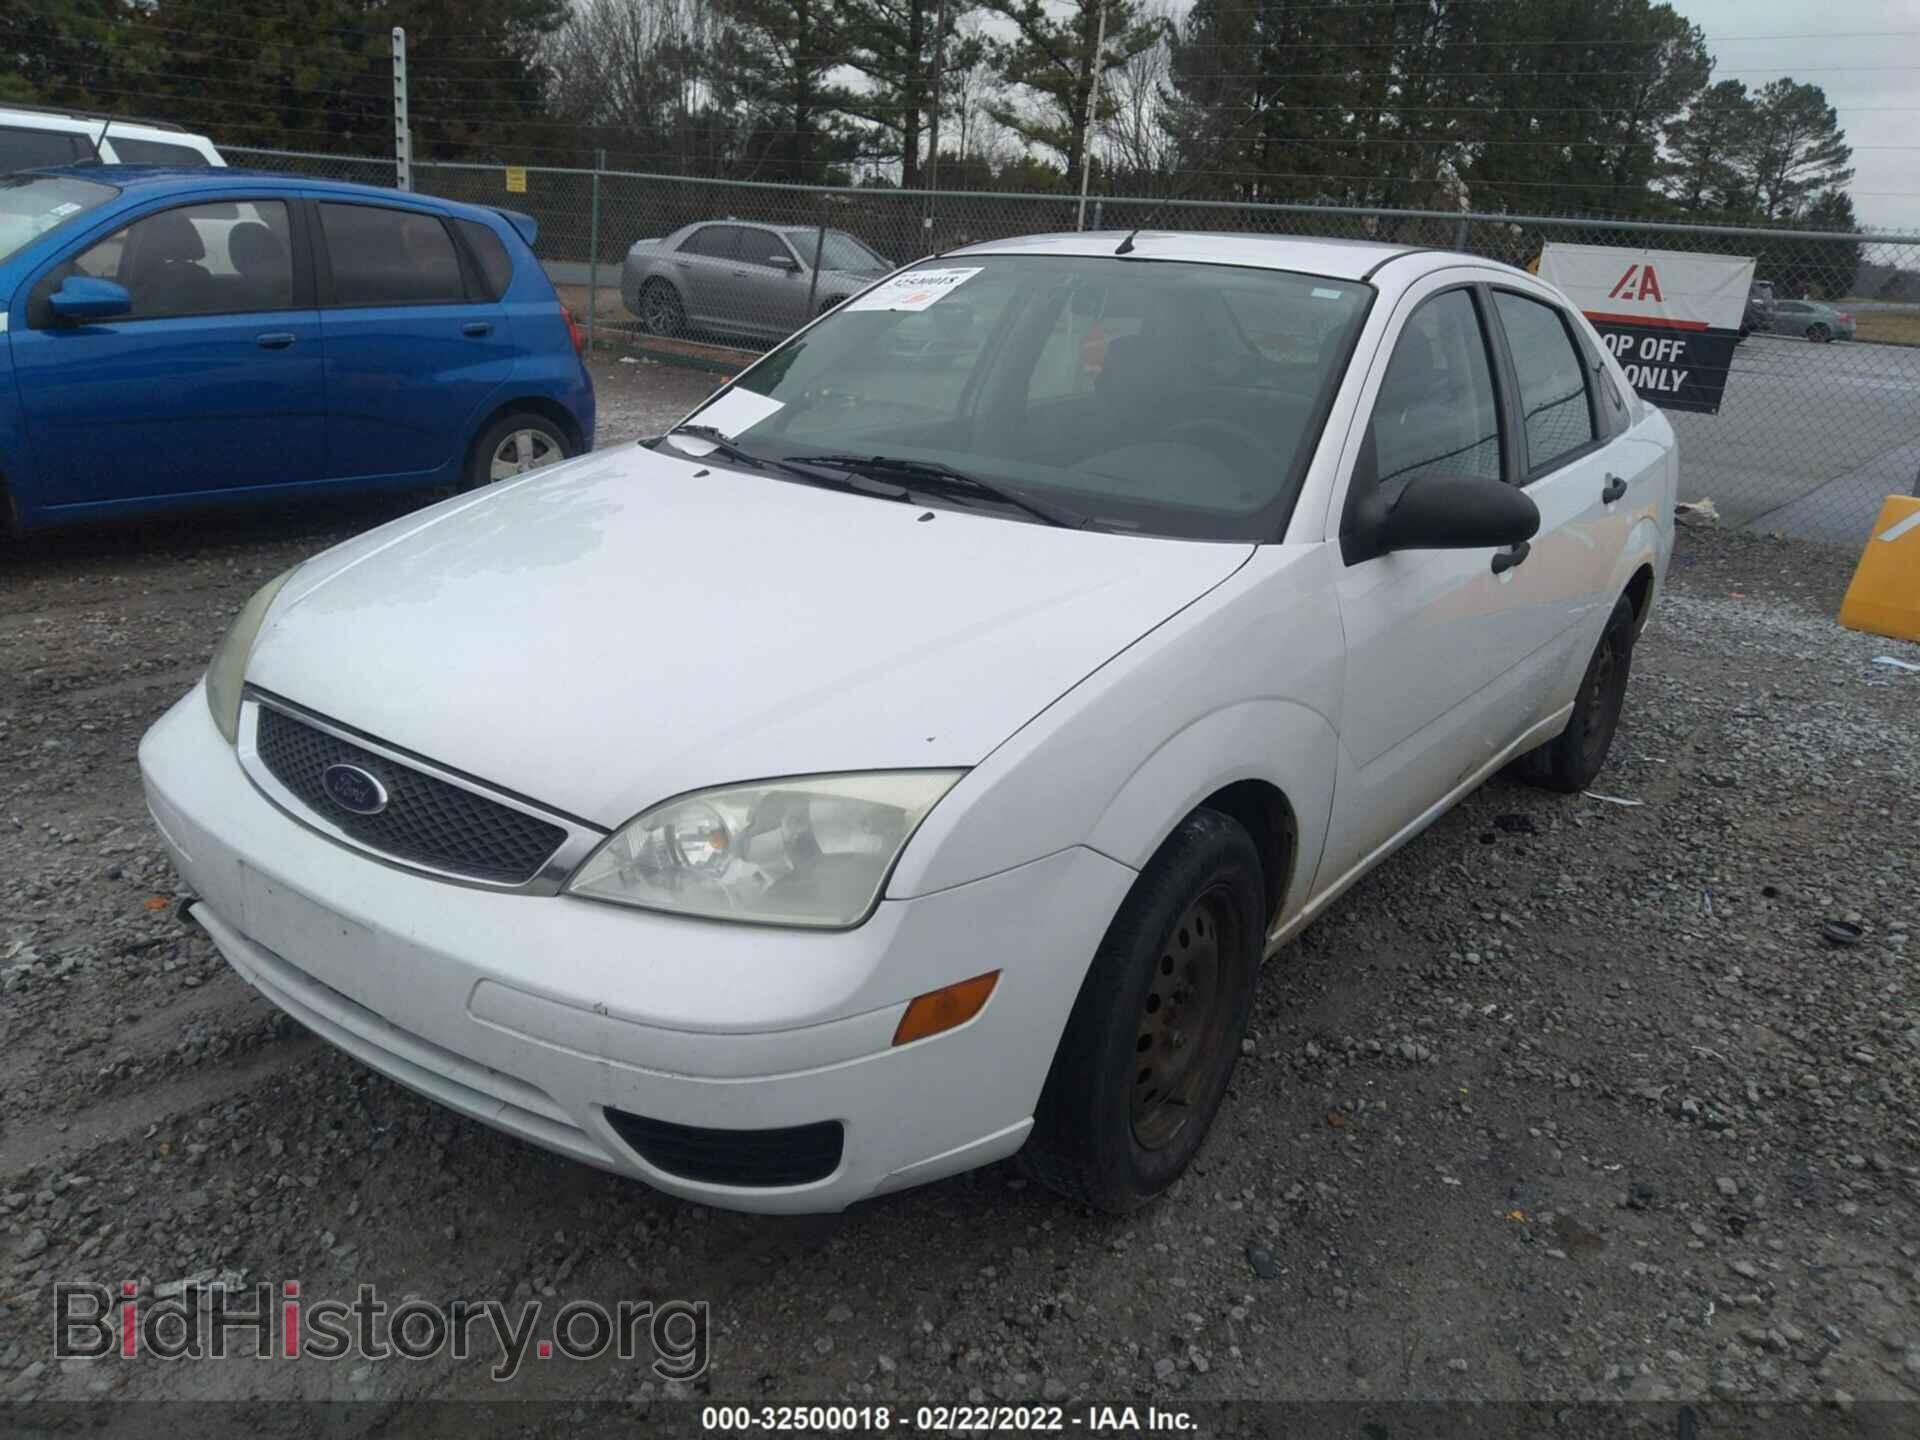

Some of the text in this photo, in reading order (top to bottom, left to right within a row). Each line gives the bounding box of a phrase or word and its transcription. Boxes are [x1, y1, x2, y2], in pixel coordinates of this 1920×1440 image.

[1602, 333, 1686, 362] OP OFF
[1624, 364, 1688, 392] ONLY
